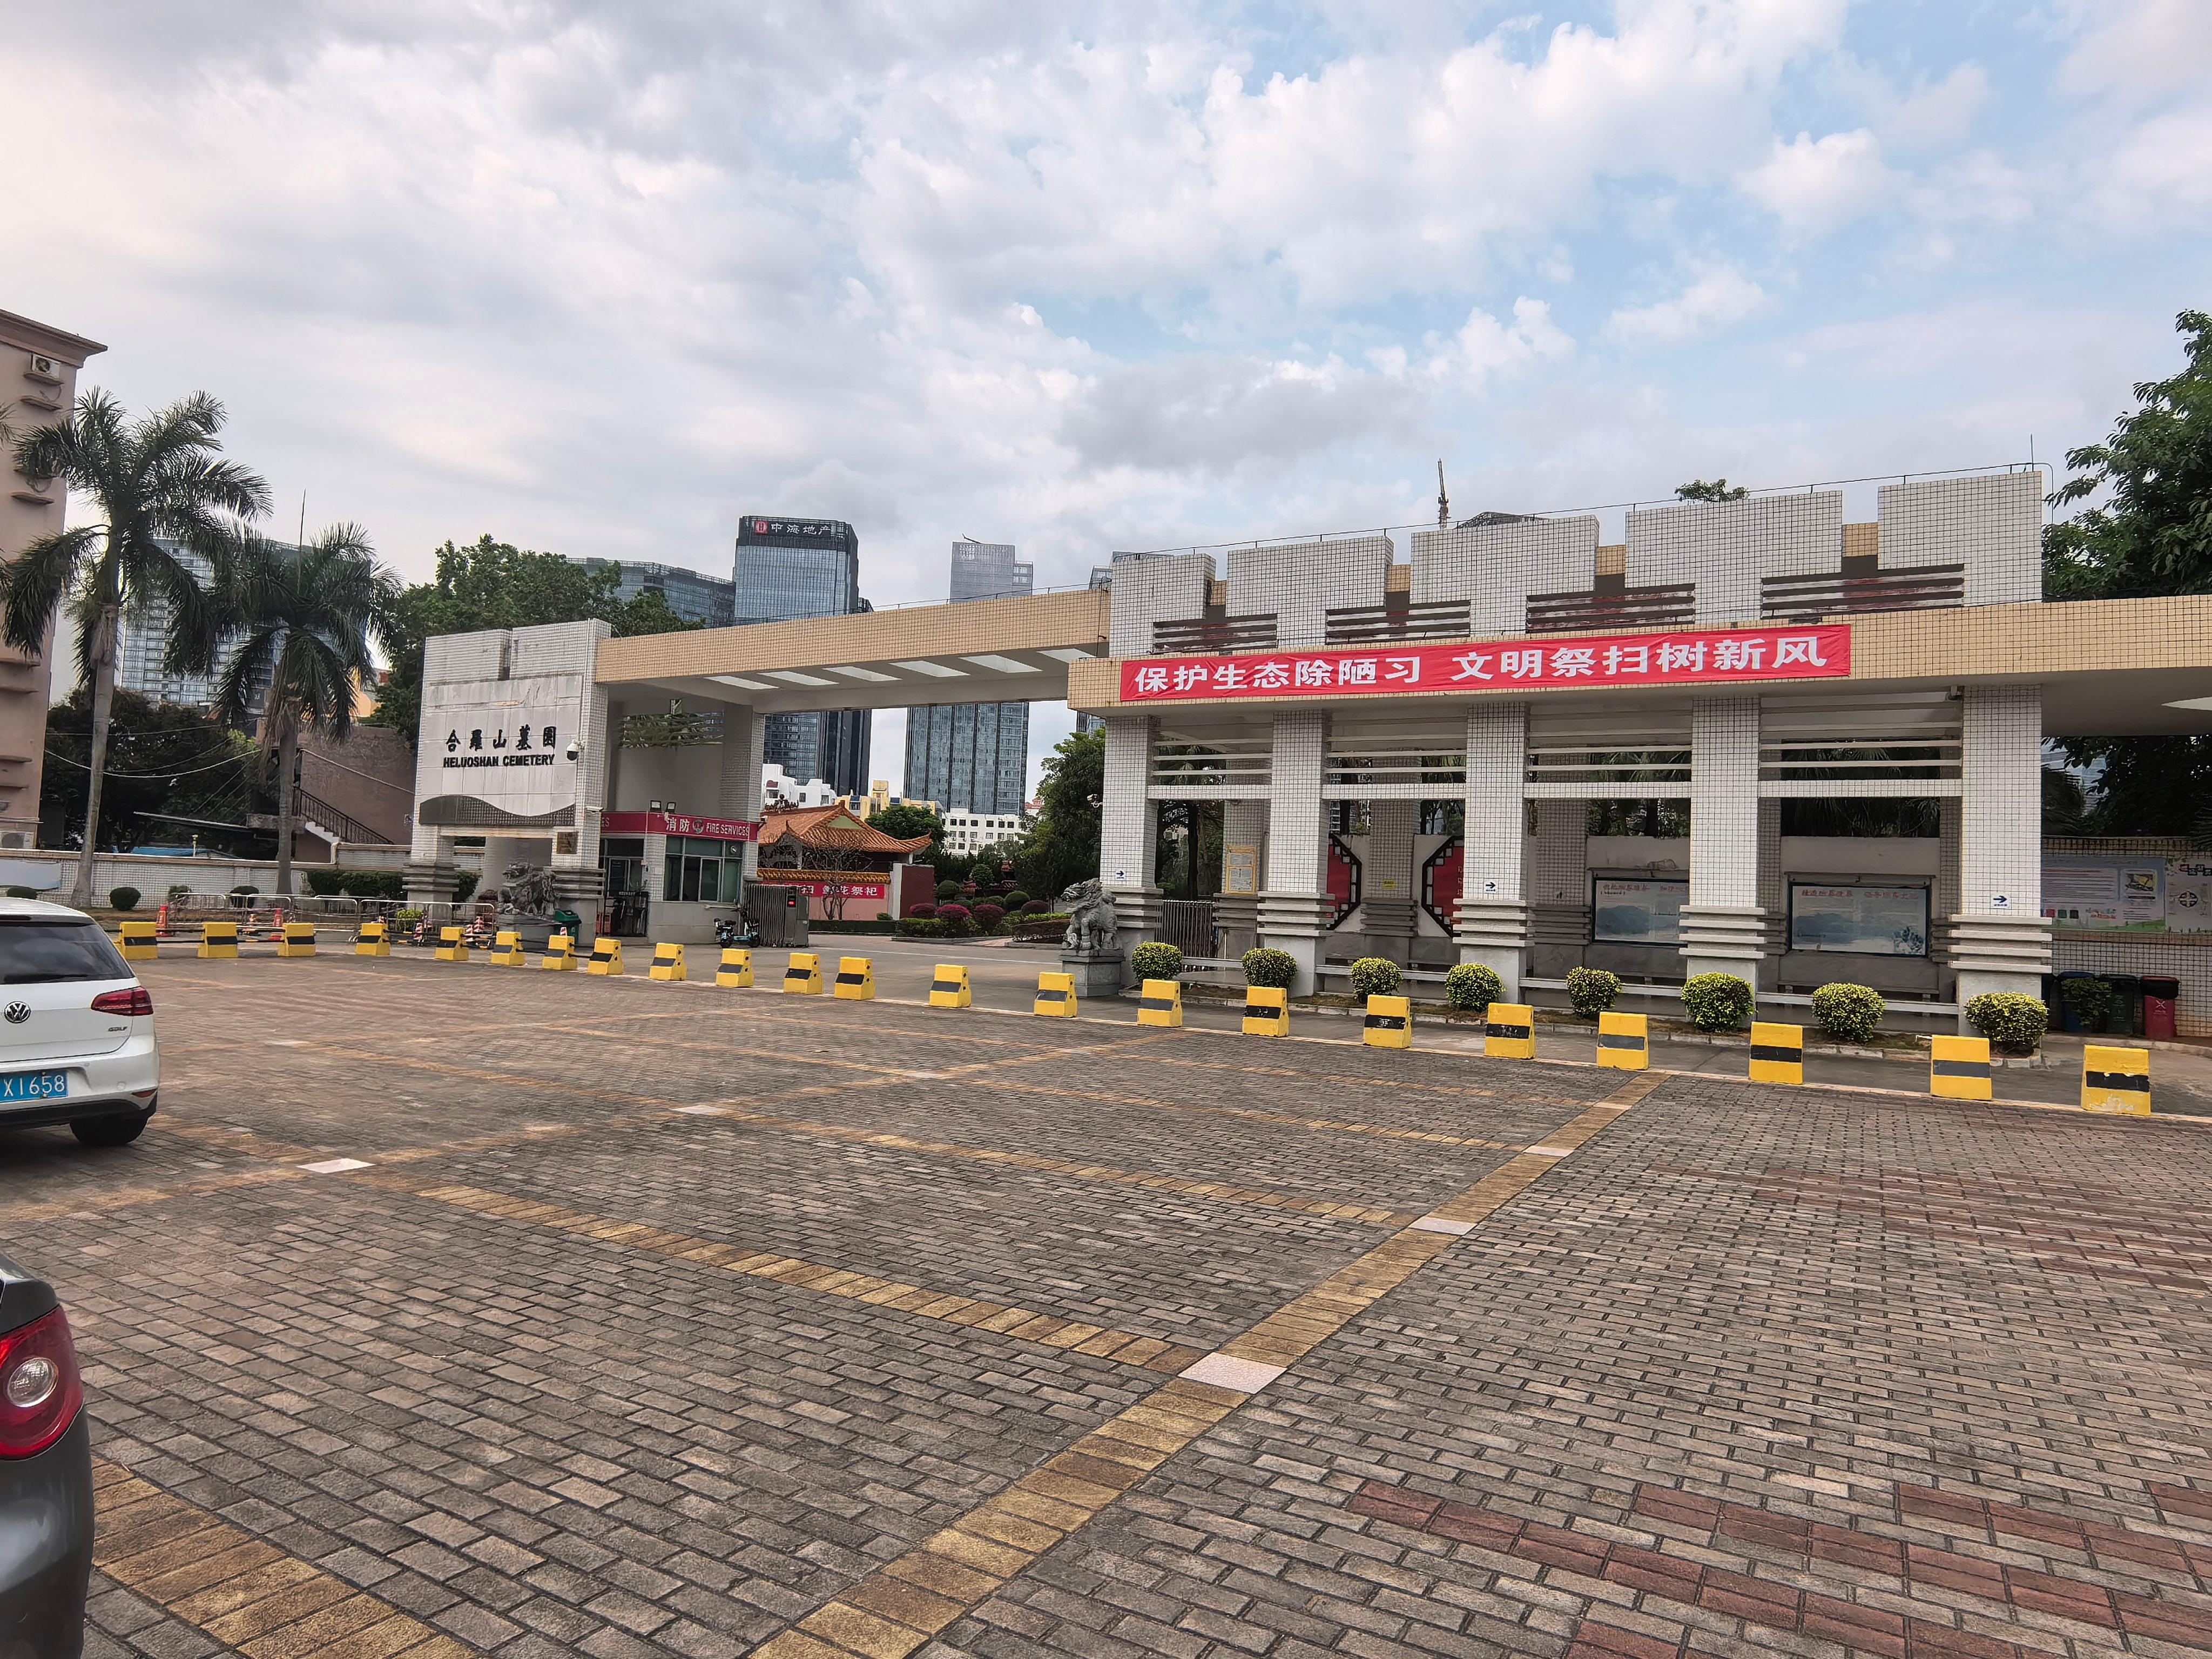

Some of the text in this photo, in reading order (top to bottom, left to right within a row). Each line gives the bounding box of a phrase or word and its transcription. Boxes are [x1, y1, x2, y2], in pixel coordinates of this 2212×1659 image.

[771, 523, 831, 535] 中海地产
[1135, 636, 1827, 692] 保护生态除陋习 文明祭扫树新风
[443, 754, 555, 767] HELUOSHAN CEMETERY
[666, 817, 690, 833] 消防
[706, 822, 749, 837] FIRE SERVICES
[4, 1075, 65, 1097] X1658
